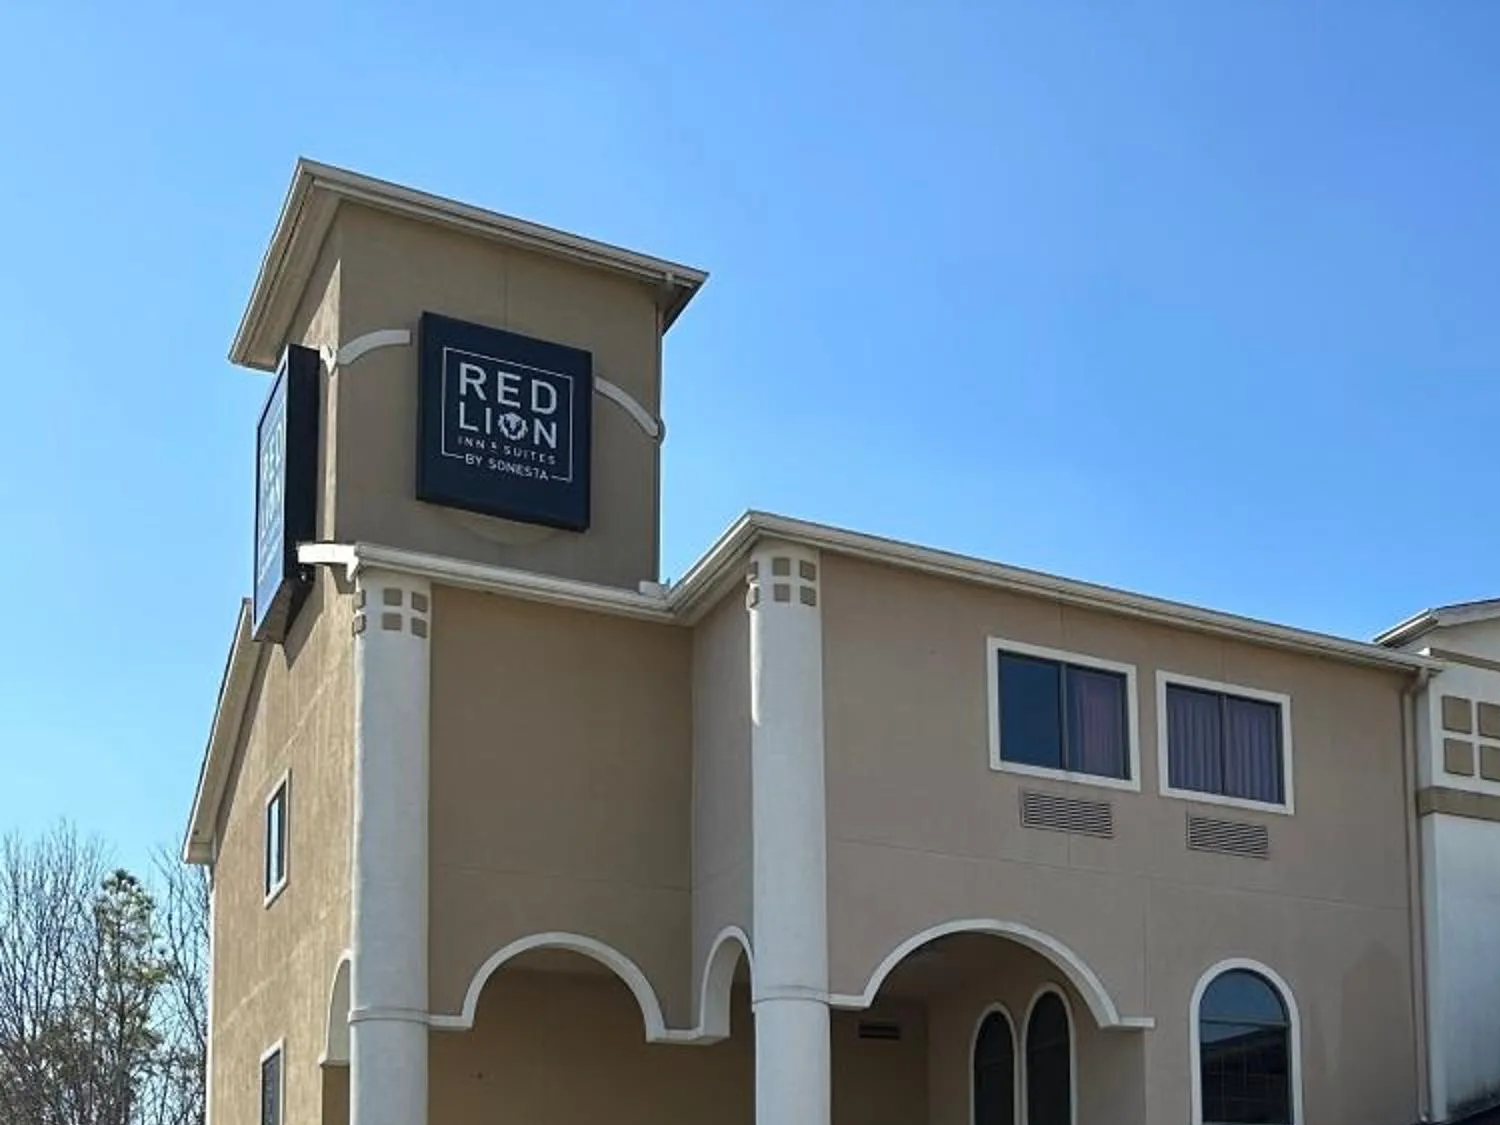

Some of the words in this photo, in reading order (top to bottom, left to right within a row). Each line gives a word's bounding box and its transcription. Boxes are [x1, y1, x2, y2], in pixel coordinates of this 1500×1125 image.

[460, 362, 557, 415] RED
[460, 401, 557, 449] LION
[458, 436, 485, 449] INN
[503, 445, 556, 465] SUITES
[465, 453, 483, 465] BY
[488, 458, 549, 480] SONESTA
